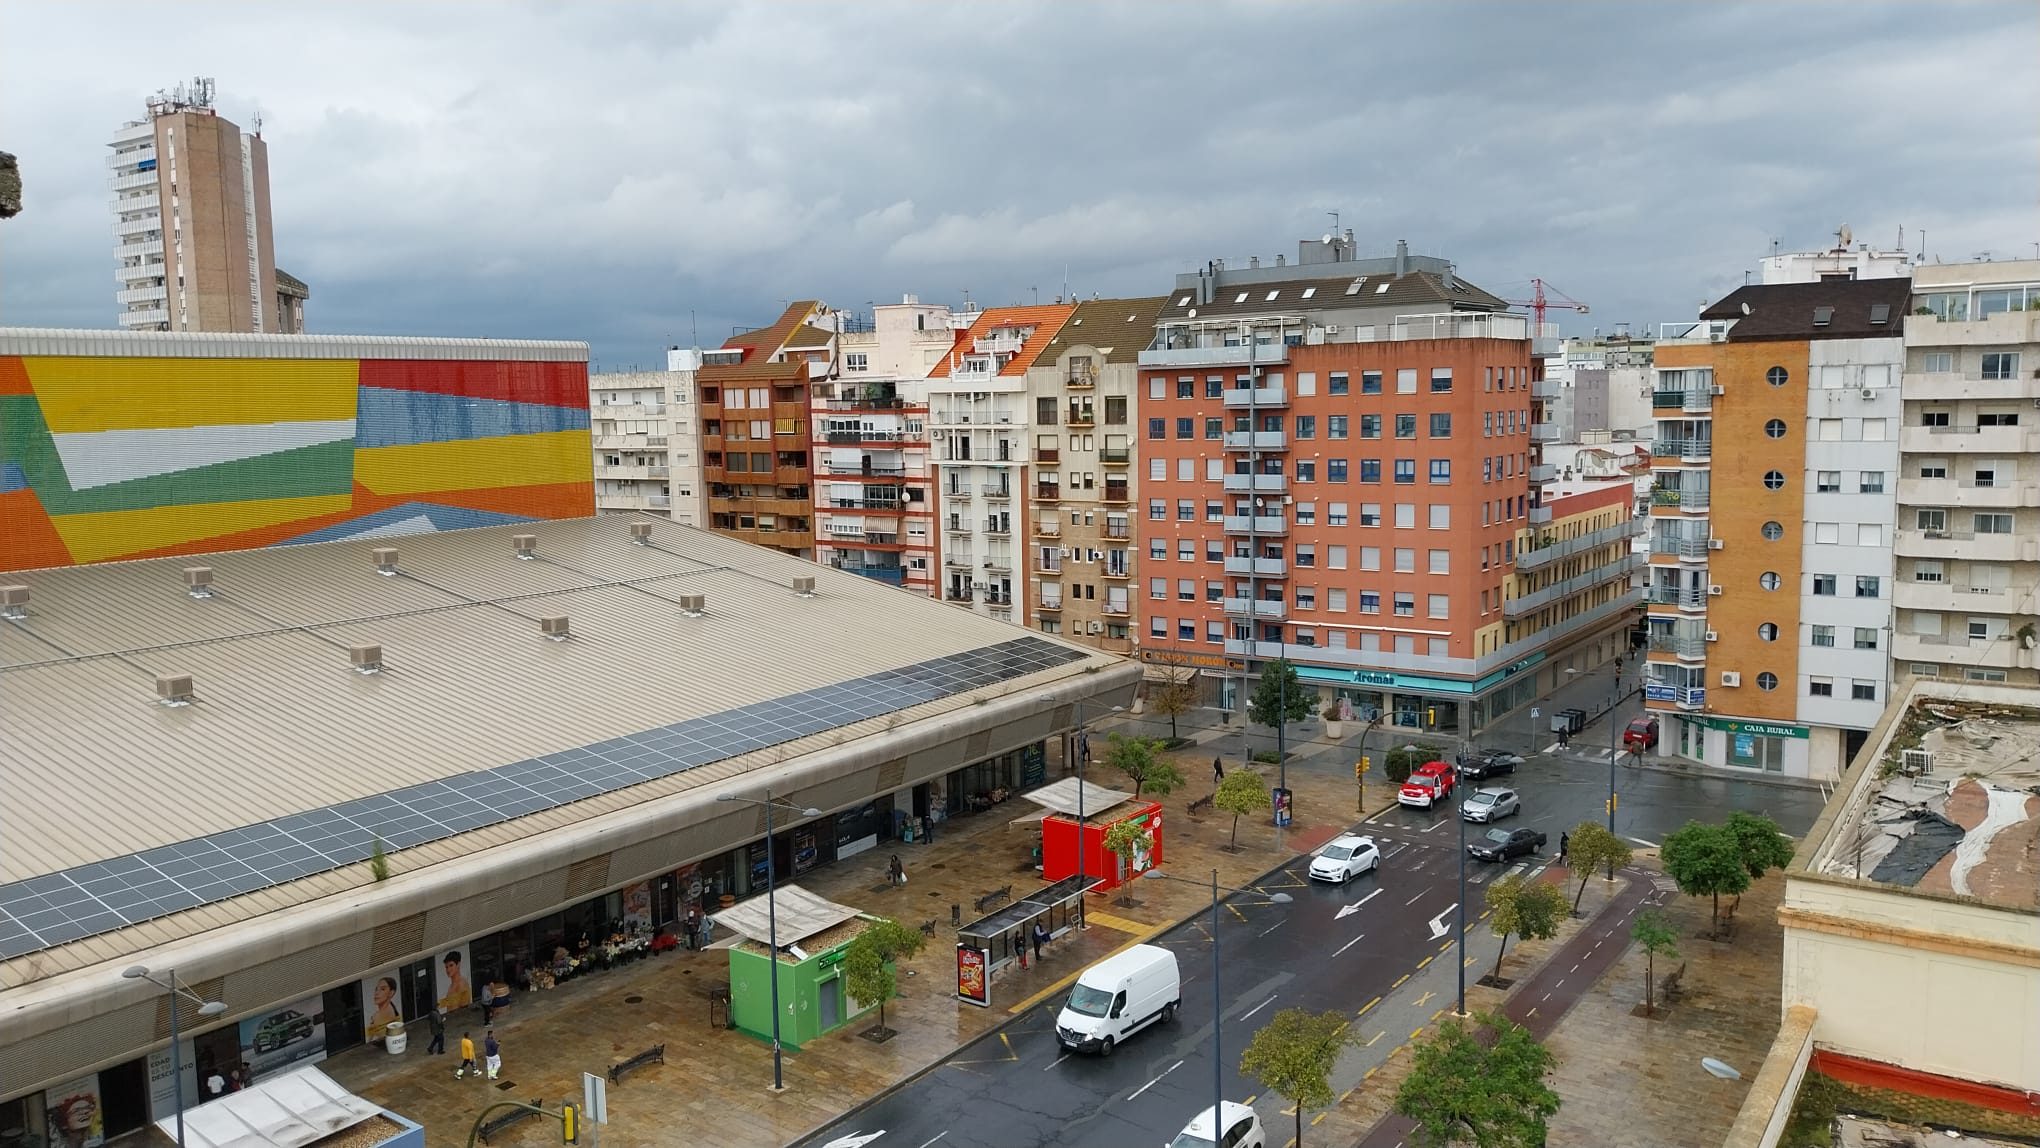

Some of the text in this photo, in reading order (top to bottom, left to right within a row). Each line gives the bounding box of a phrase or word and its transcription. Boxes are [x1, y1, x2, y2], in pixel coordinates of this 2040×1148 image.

[1354, 672, 1394, 684] Aromas
[1766, 726, 1796, 736] RURAL
[152, 1062, 194, 1081] DESCUNTO
